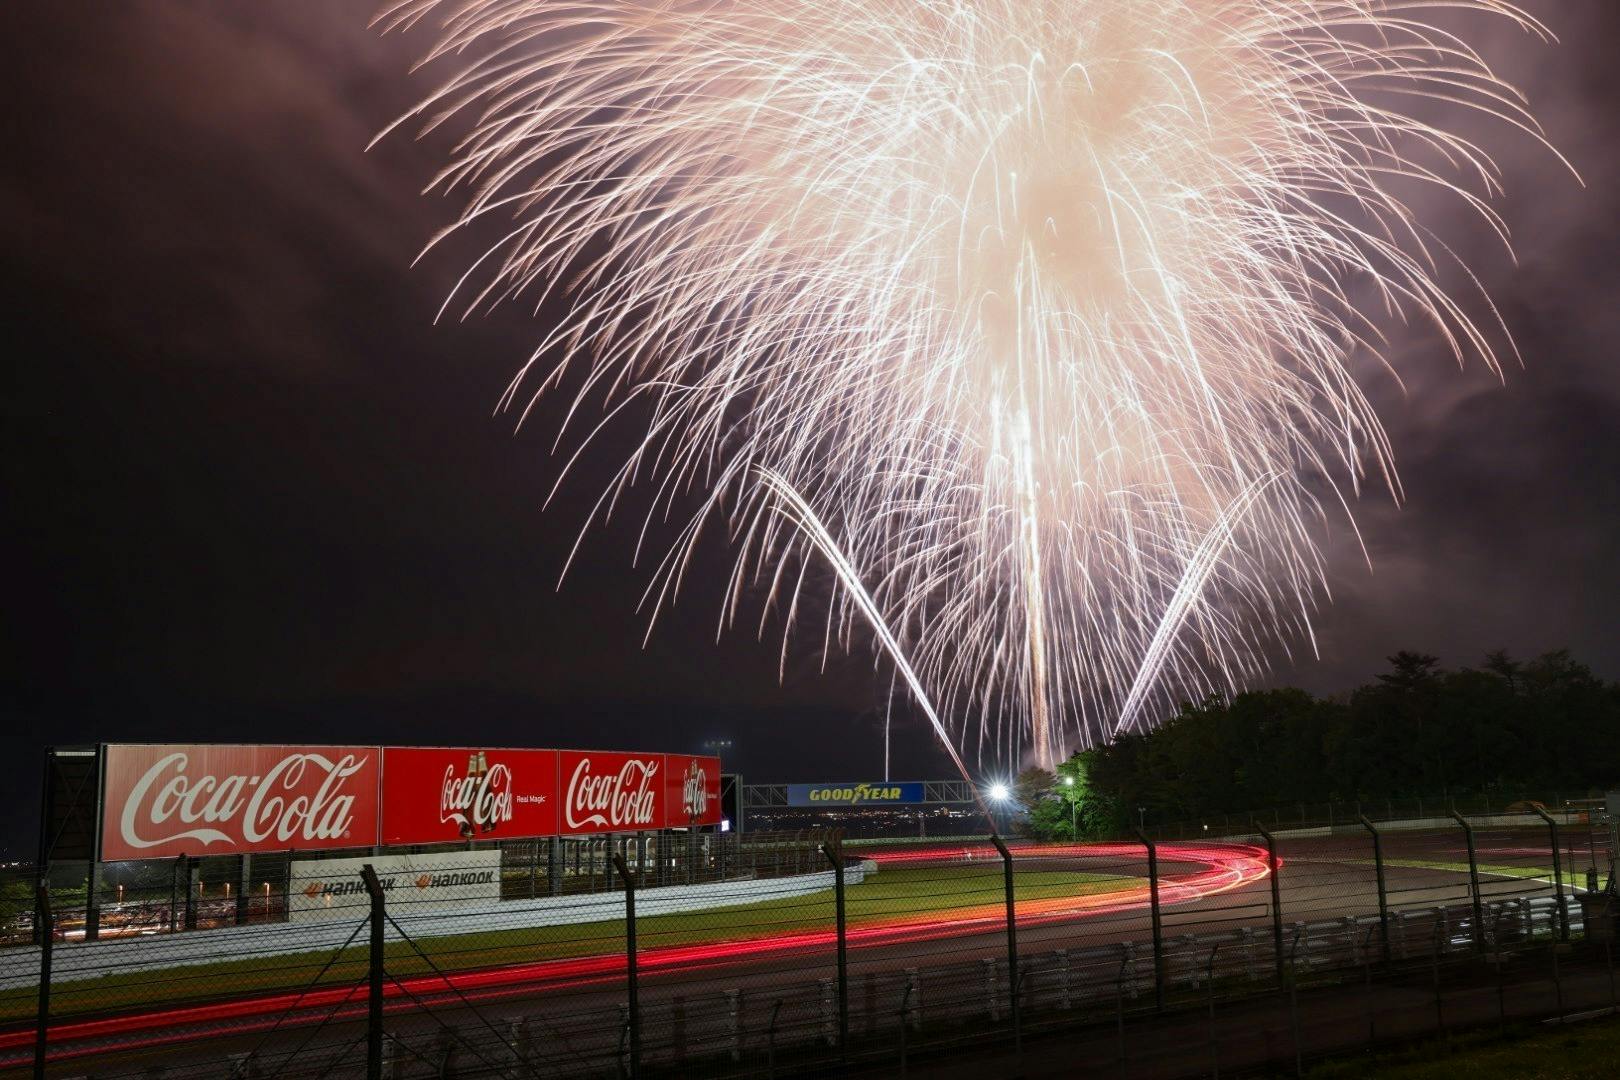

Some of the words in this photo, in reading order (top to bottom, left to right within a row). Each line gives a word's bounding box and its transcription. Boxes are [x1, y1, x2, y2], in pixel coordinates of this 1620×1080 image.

[121, 753, 368, 848] Coca-Cola
[440, 764, 512, 825] Coca-Cola
[566, 758, 660, 829] Coca-Cola
[809, 785, 901, 802] GOODYEAR
